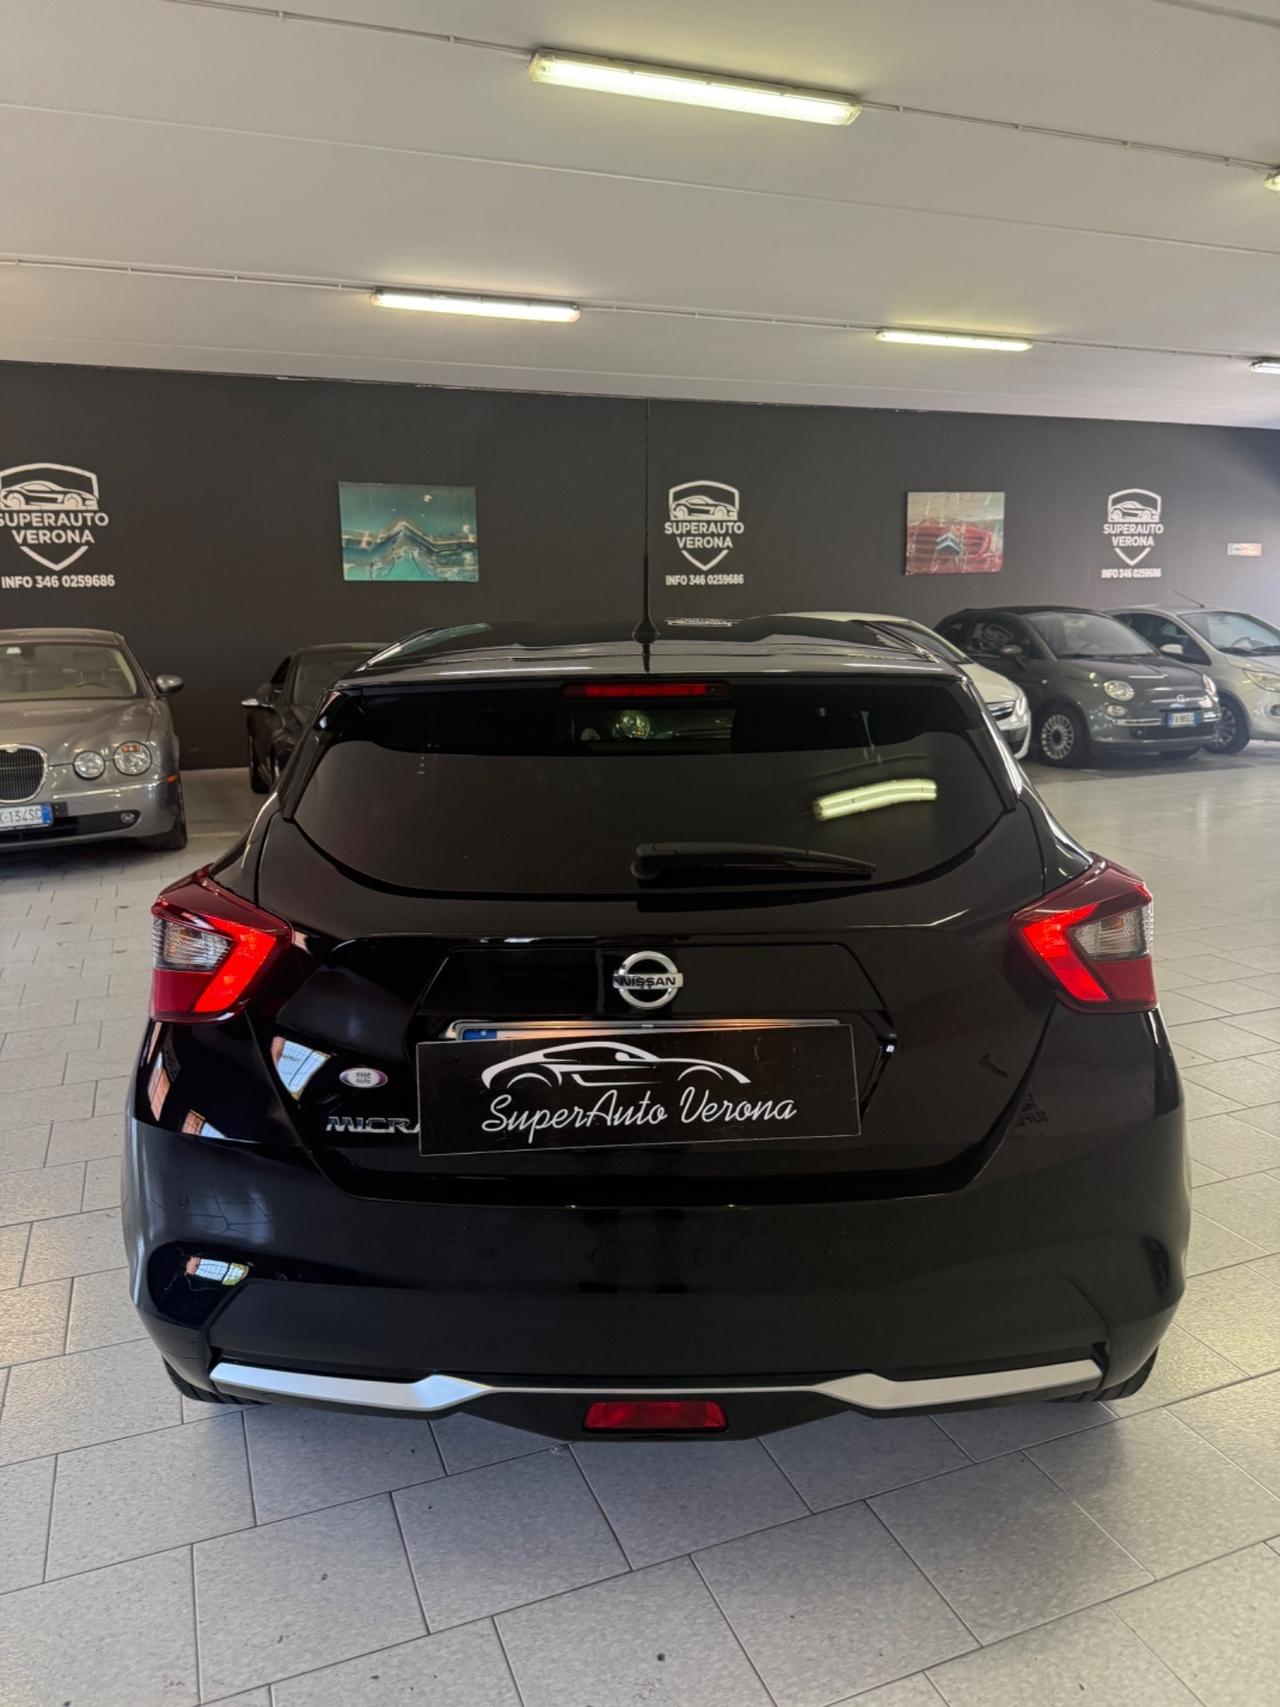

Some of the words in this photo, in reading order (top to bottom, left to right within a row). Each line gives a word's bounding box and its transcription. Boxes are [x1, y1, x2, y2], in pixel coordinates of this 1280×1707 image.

[664, 521, 745, 534] SUPERAUTO
[1103, 523, 1164, 534] SUPERAUTO
[11, 529, 96, 544] VERONA
[676, 536, 733, 549] VERONA
[1111, 535, 1155, 547] VERONA
[1, 575, 33, 589] INFO
[34, 575, 60, 588] 346
[61, 574, 116, 587] 0259686
[665, 575, 688, 586] INFO
[622, 976, 676, 987] NISSAN
[481, 1089, 668, 1144] SuperAuto
[679, 1086, 798, 1124] Verona
